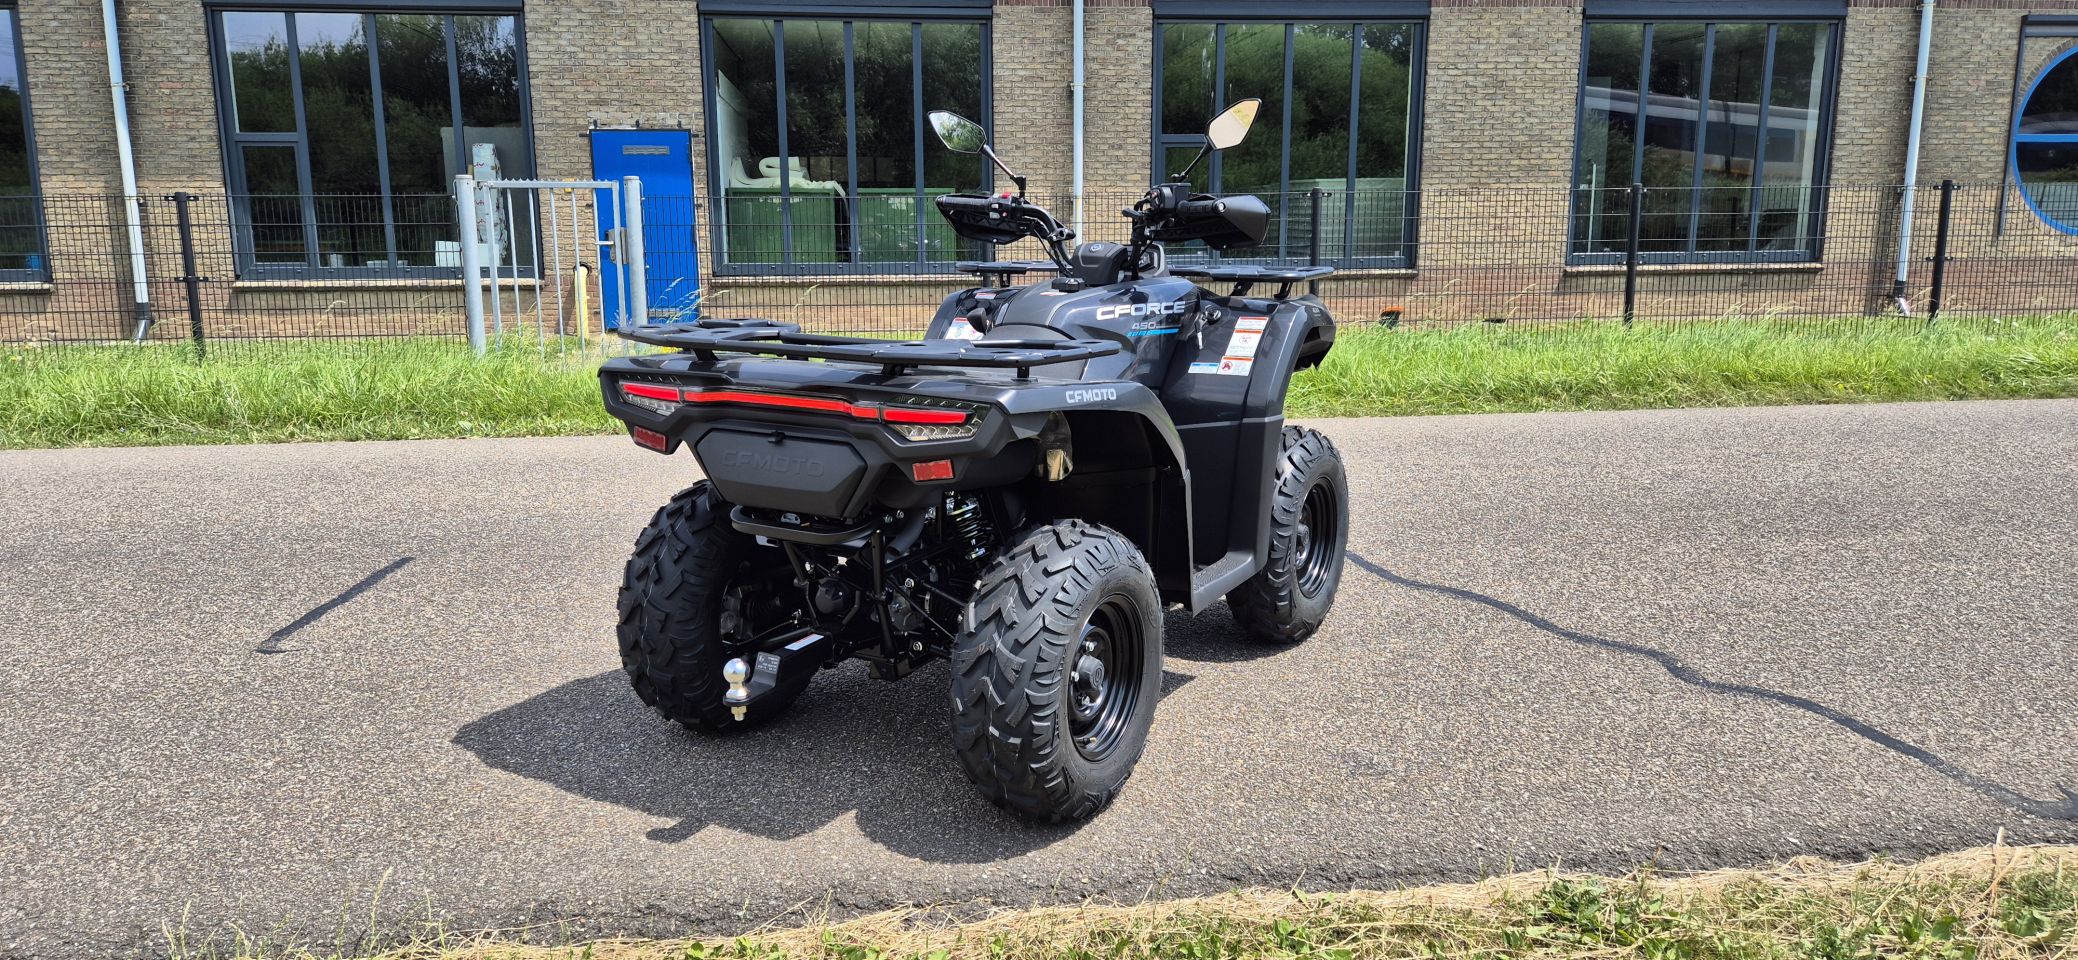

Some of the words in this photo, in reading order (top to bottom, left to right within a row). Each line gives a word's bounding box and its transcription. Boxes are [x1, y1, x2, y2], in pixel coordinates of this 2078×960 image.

[1096, 301, 1186, 321] CFORCE
[1132, 321, 1157, 330] 450
[1065, 388, 1117, 404] CFMOTO
[721, 450, 825, 477] CFMOTO
